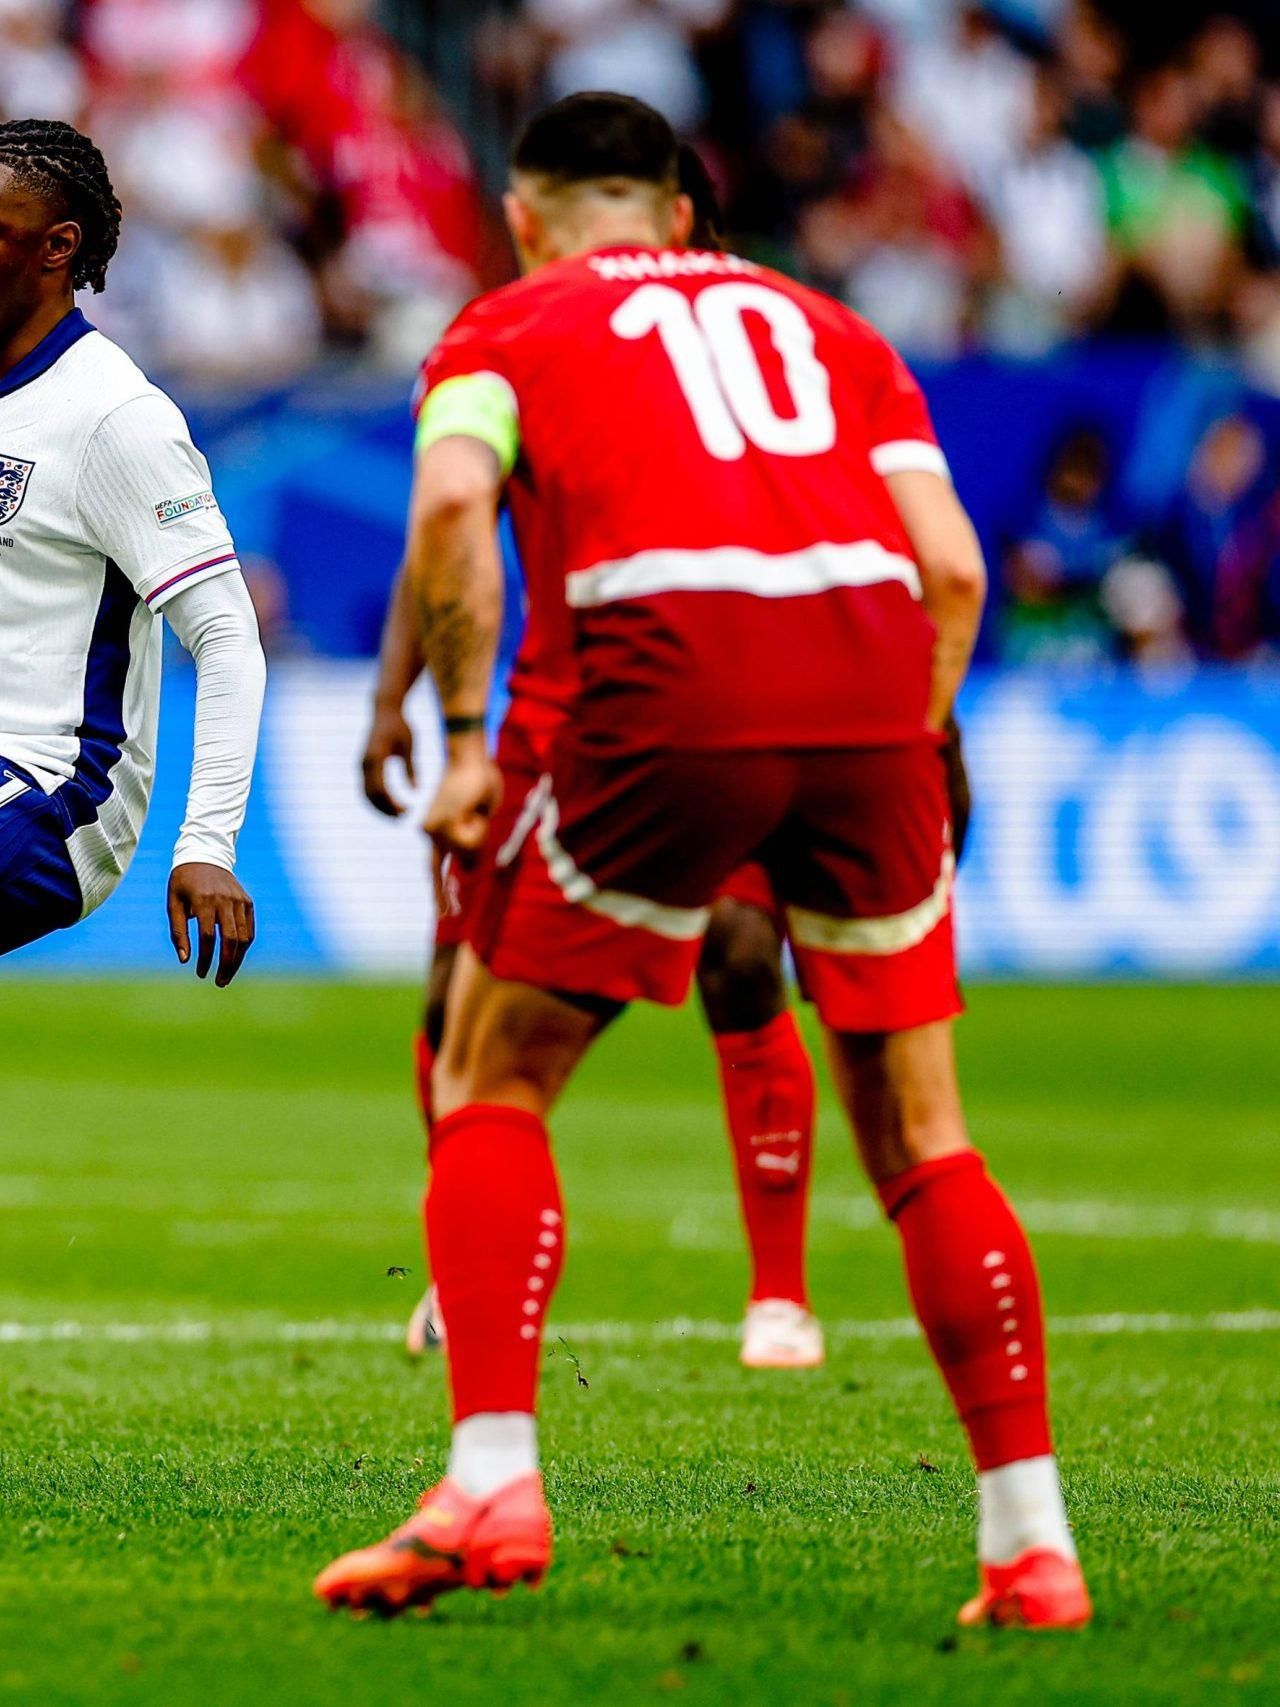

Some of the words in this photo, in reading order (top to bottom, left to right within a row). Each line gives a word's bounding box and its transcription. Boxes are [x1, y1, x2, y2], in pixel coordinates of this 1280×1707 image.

[609, 281, 837, 461] 10
[155, 500, 172, 510] UEFA
[157, 493, 214, 520] FOUNDATIO
